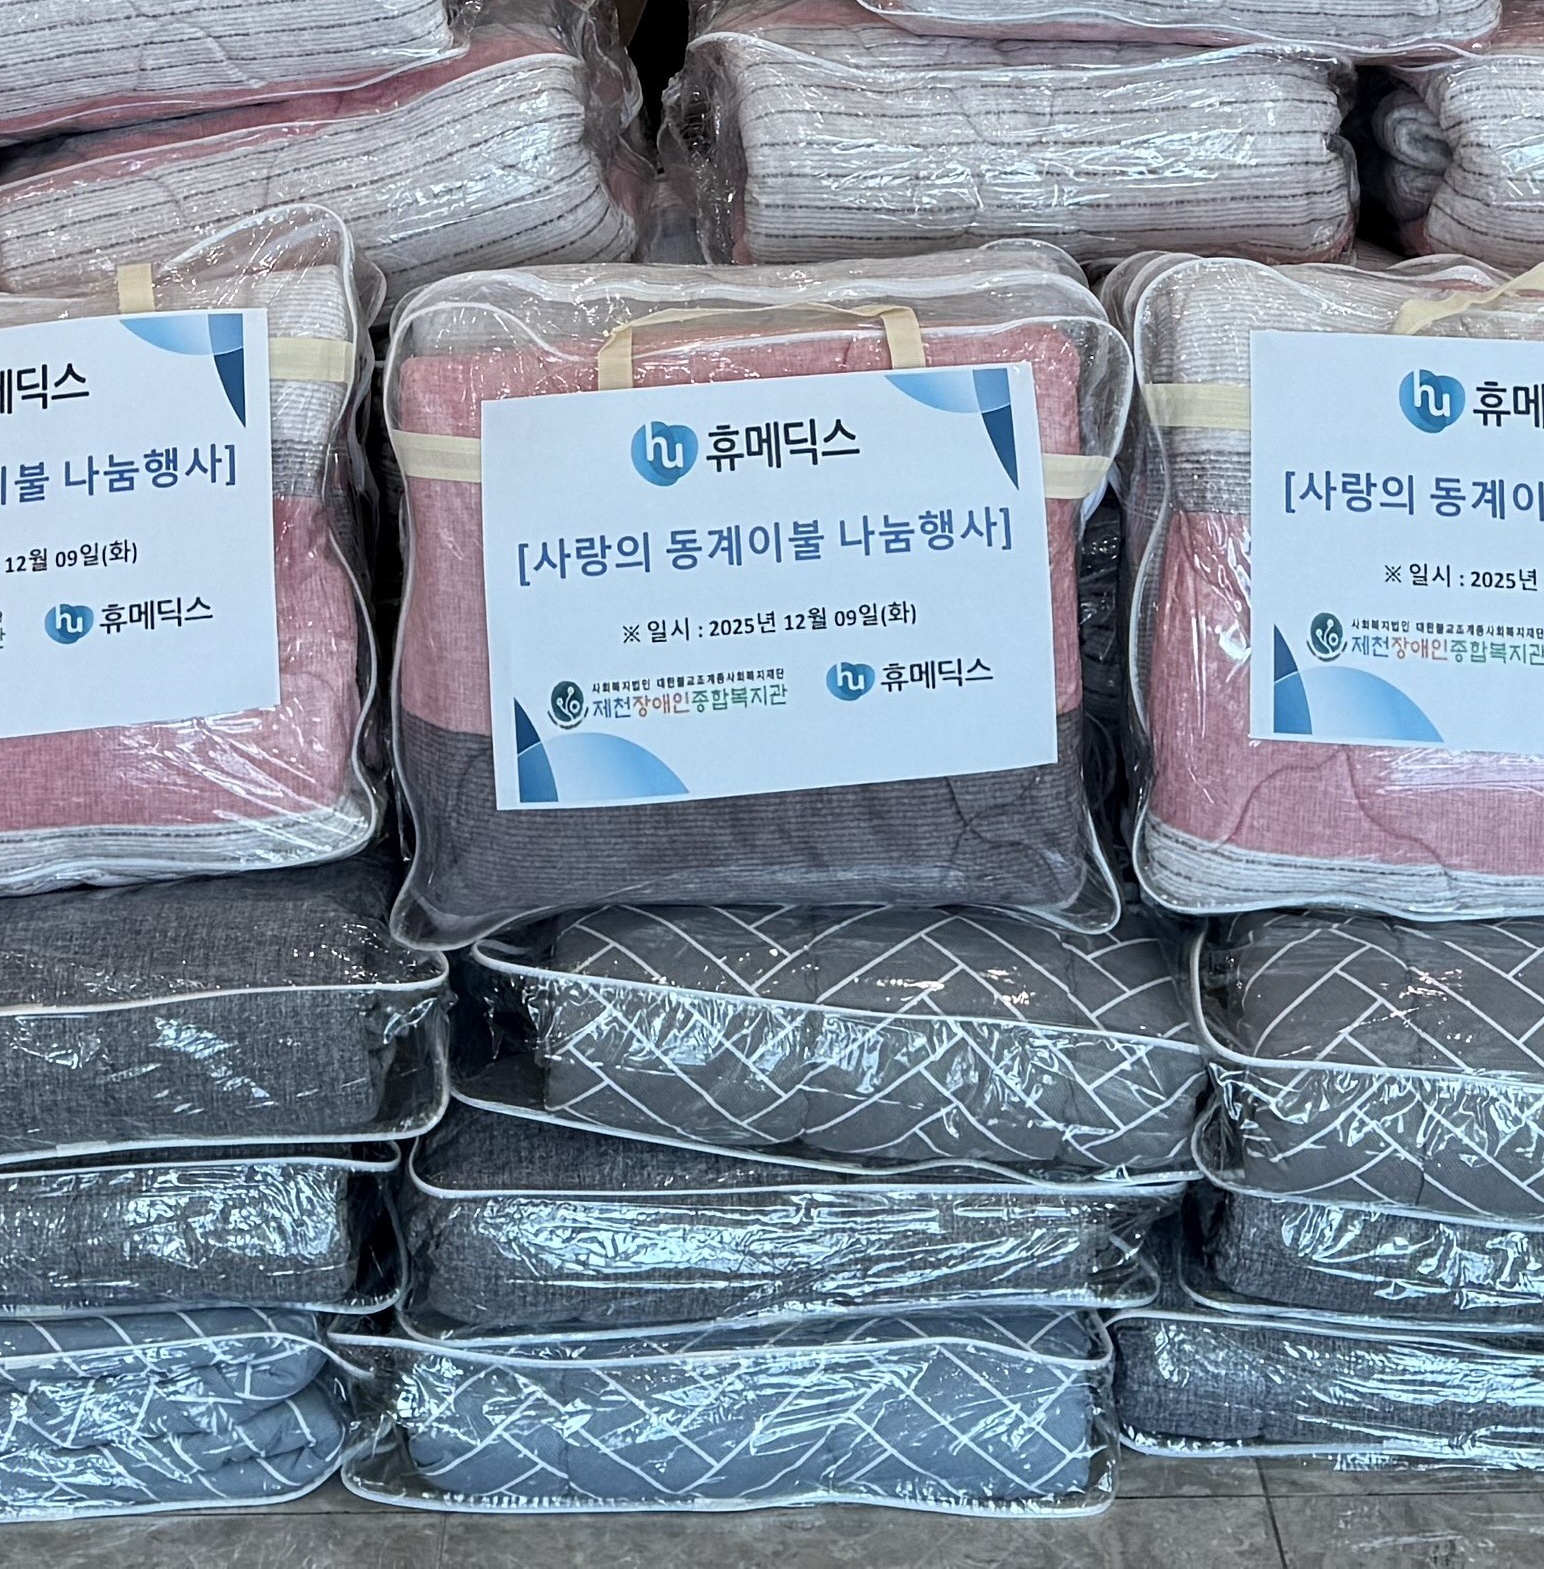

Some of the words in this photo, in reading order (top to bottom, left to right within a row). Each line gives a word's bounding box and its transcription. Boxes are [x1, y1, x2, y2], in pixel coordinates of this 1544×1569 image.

[706, 419, 860, 472] 휴메딕스
[65, 444, 235, 495] 나눔행사]
[1286, 471, 1414, 515] [사랑의
[6, 548, 47, 573] 12월
[56, 540, 137, 567] 09일(화)
[519, 532, 650, 586] [사랑의
[666, 520, 824, 570] 동계이불
[840, 507, 1011, 556] 나눔행사]
[1410, 564, 1450, 587] 일시
[1471, 569, 1537, 591] 2025년
[100, 597, 213, 634] 휴메딕스
[648, 618, 689, 642] 일시
[709, 611, 775, 636] 2025년
[785, 607, 826, 630] 12월
[835, 601, 916, 626] 09일(화)
[881, 658, 993, 692] 휴메딕스
[593, 684, 788, 719] 제천장애인종합복지관
